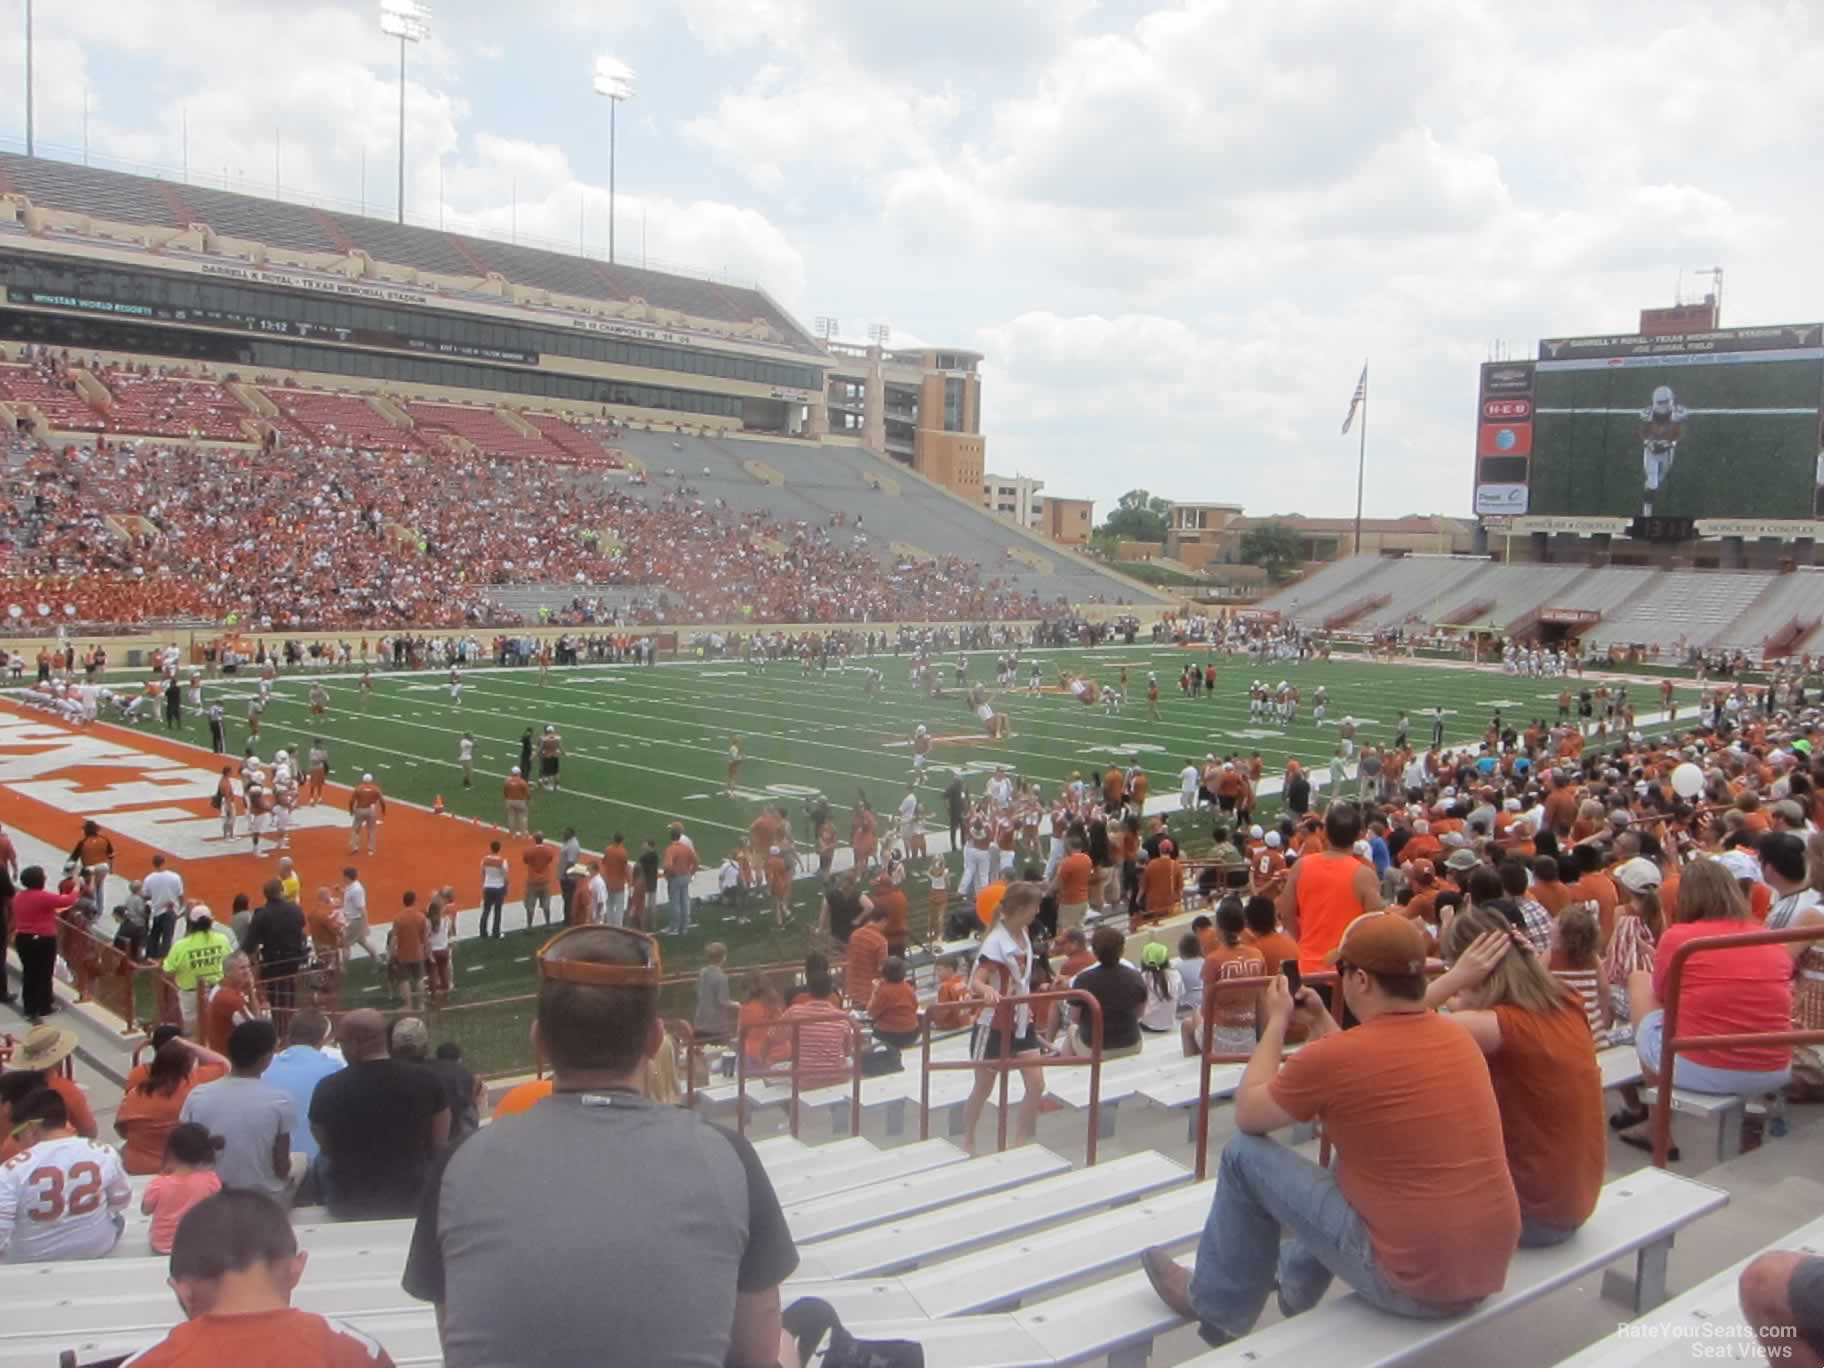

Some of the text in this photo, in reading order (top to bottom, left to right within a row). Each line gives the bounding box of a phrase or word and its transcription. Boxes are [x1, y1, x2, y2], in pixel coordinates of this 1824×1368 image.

[302, 278, 335, 292] TEXAS
[387, 291, 427, 304] STADIUM
[1655, 334, 1684, 344] TEXAS
[1687, 341, 1715, 352] FIELD
[1260, 855, 1270, 874] 8
[189, 945, 223, 959] EVENT
[190, 956, 223, 969] STAFF
[28, 1161, 102, 1222] 32
